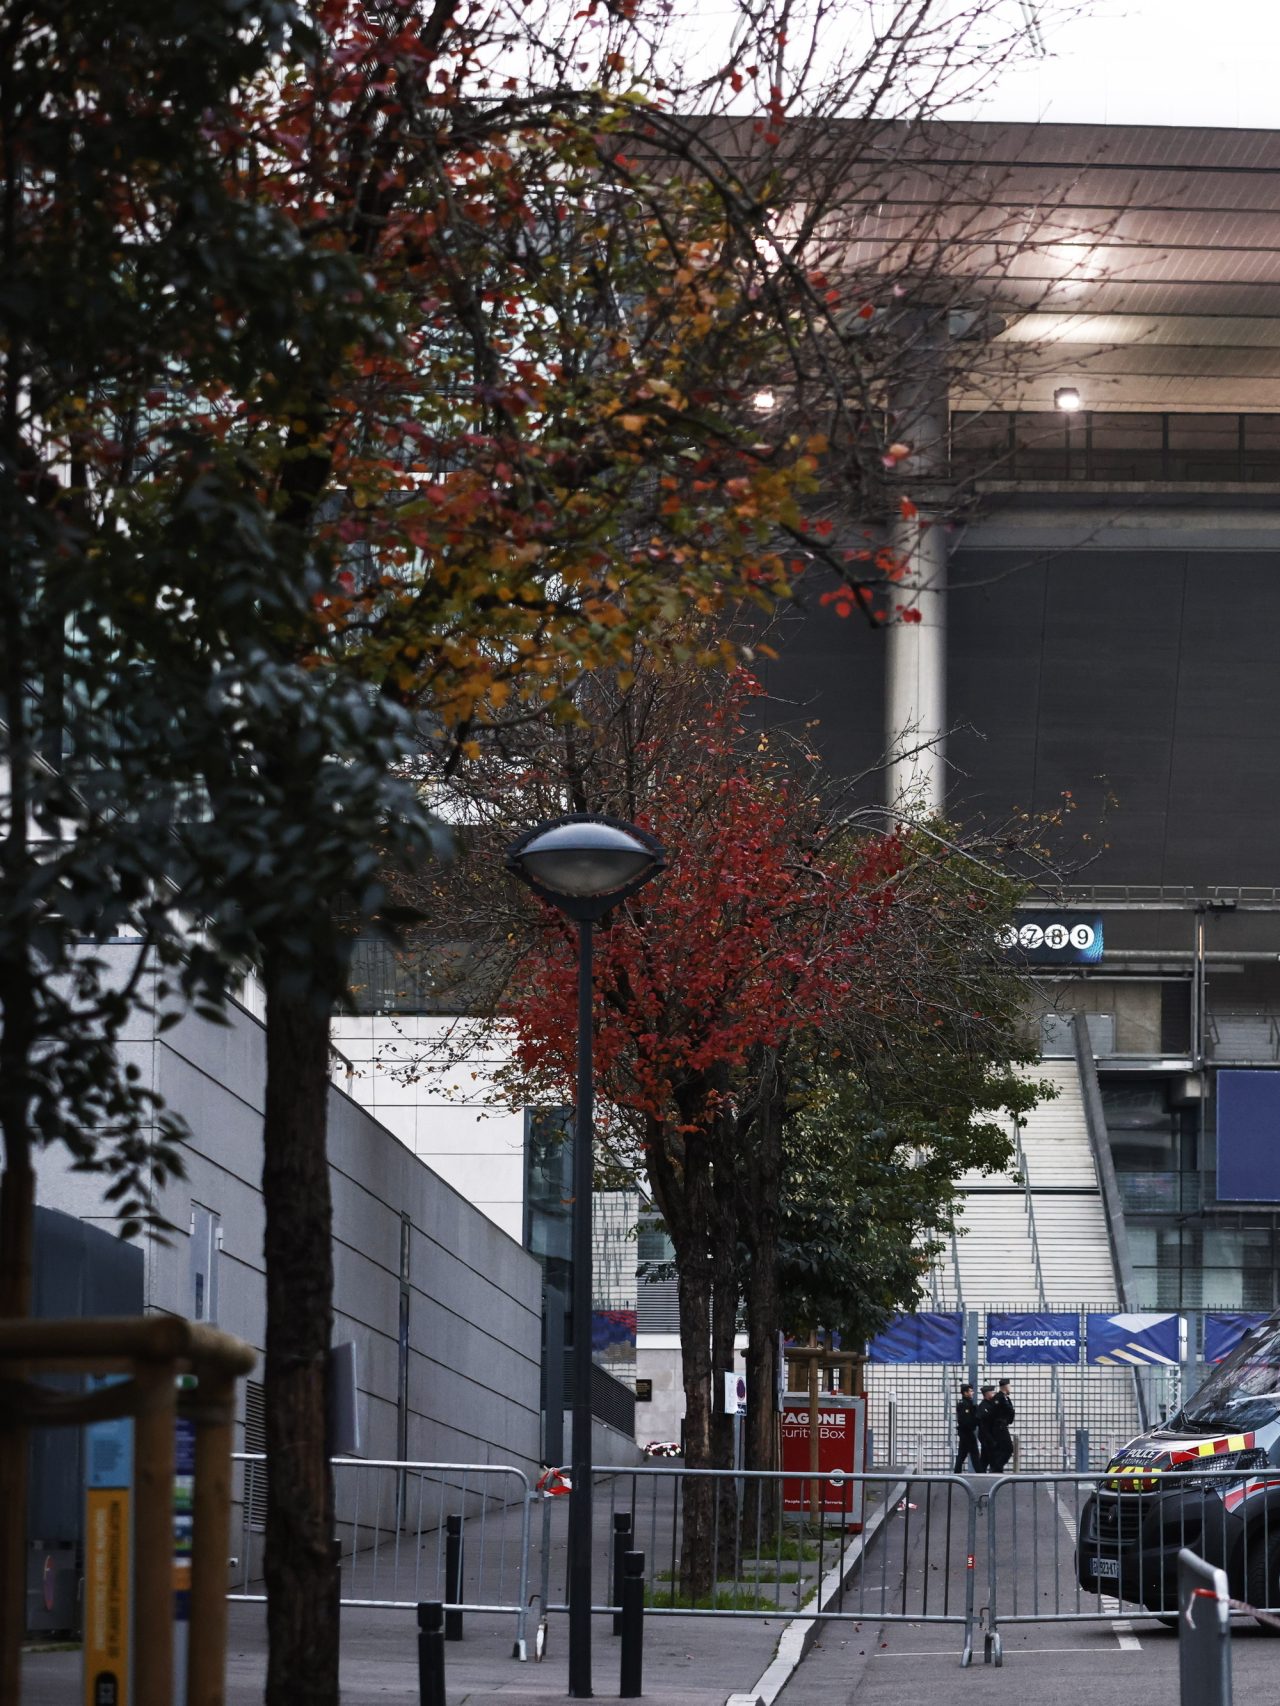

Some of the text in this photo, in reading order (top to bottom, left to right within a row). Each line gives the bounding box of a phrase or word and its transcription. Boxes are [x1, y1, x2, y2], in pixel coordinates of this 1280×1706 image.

[1027, 929, 1037, 944] 7
[1051, 929, 1062, 945] 8
[1077, 929, 1088, 945] 9
[990, 1336, 1076, 1348] @equipedefrance
[820, 1428, 845, 1439] Box
[1125, 1449, 1156, 1458] POLICE
